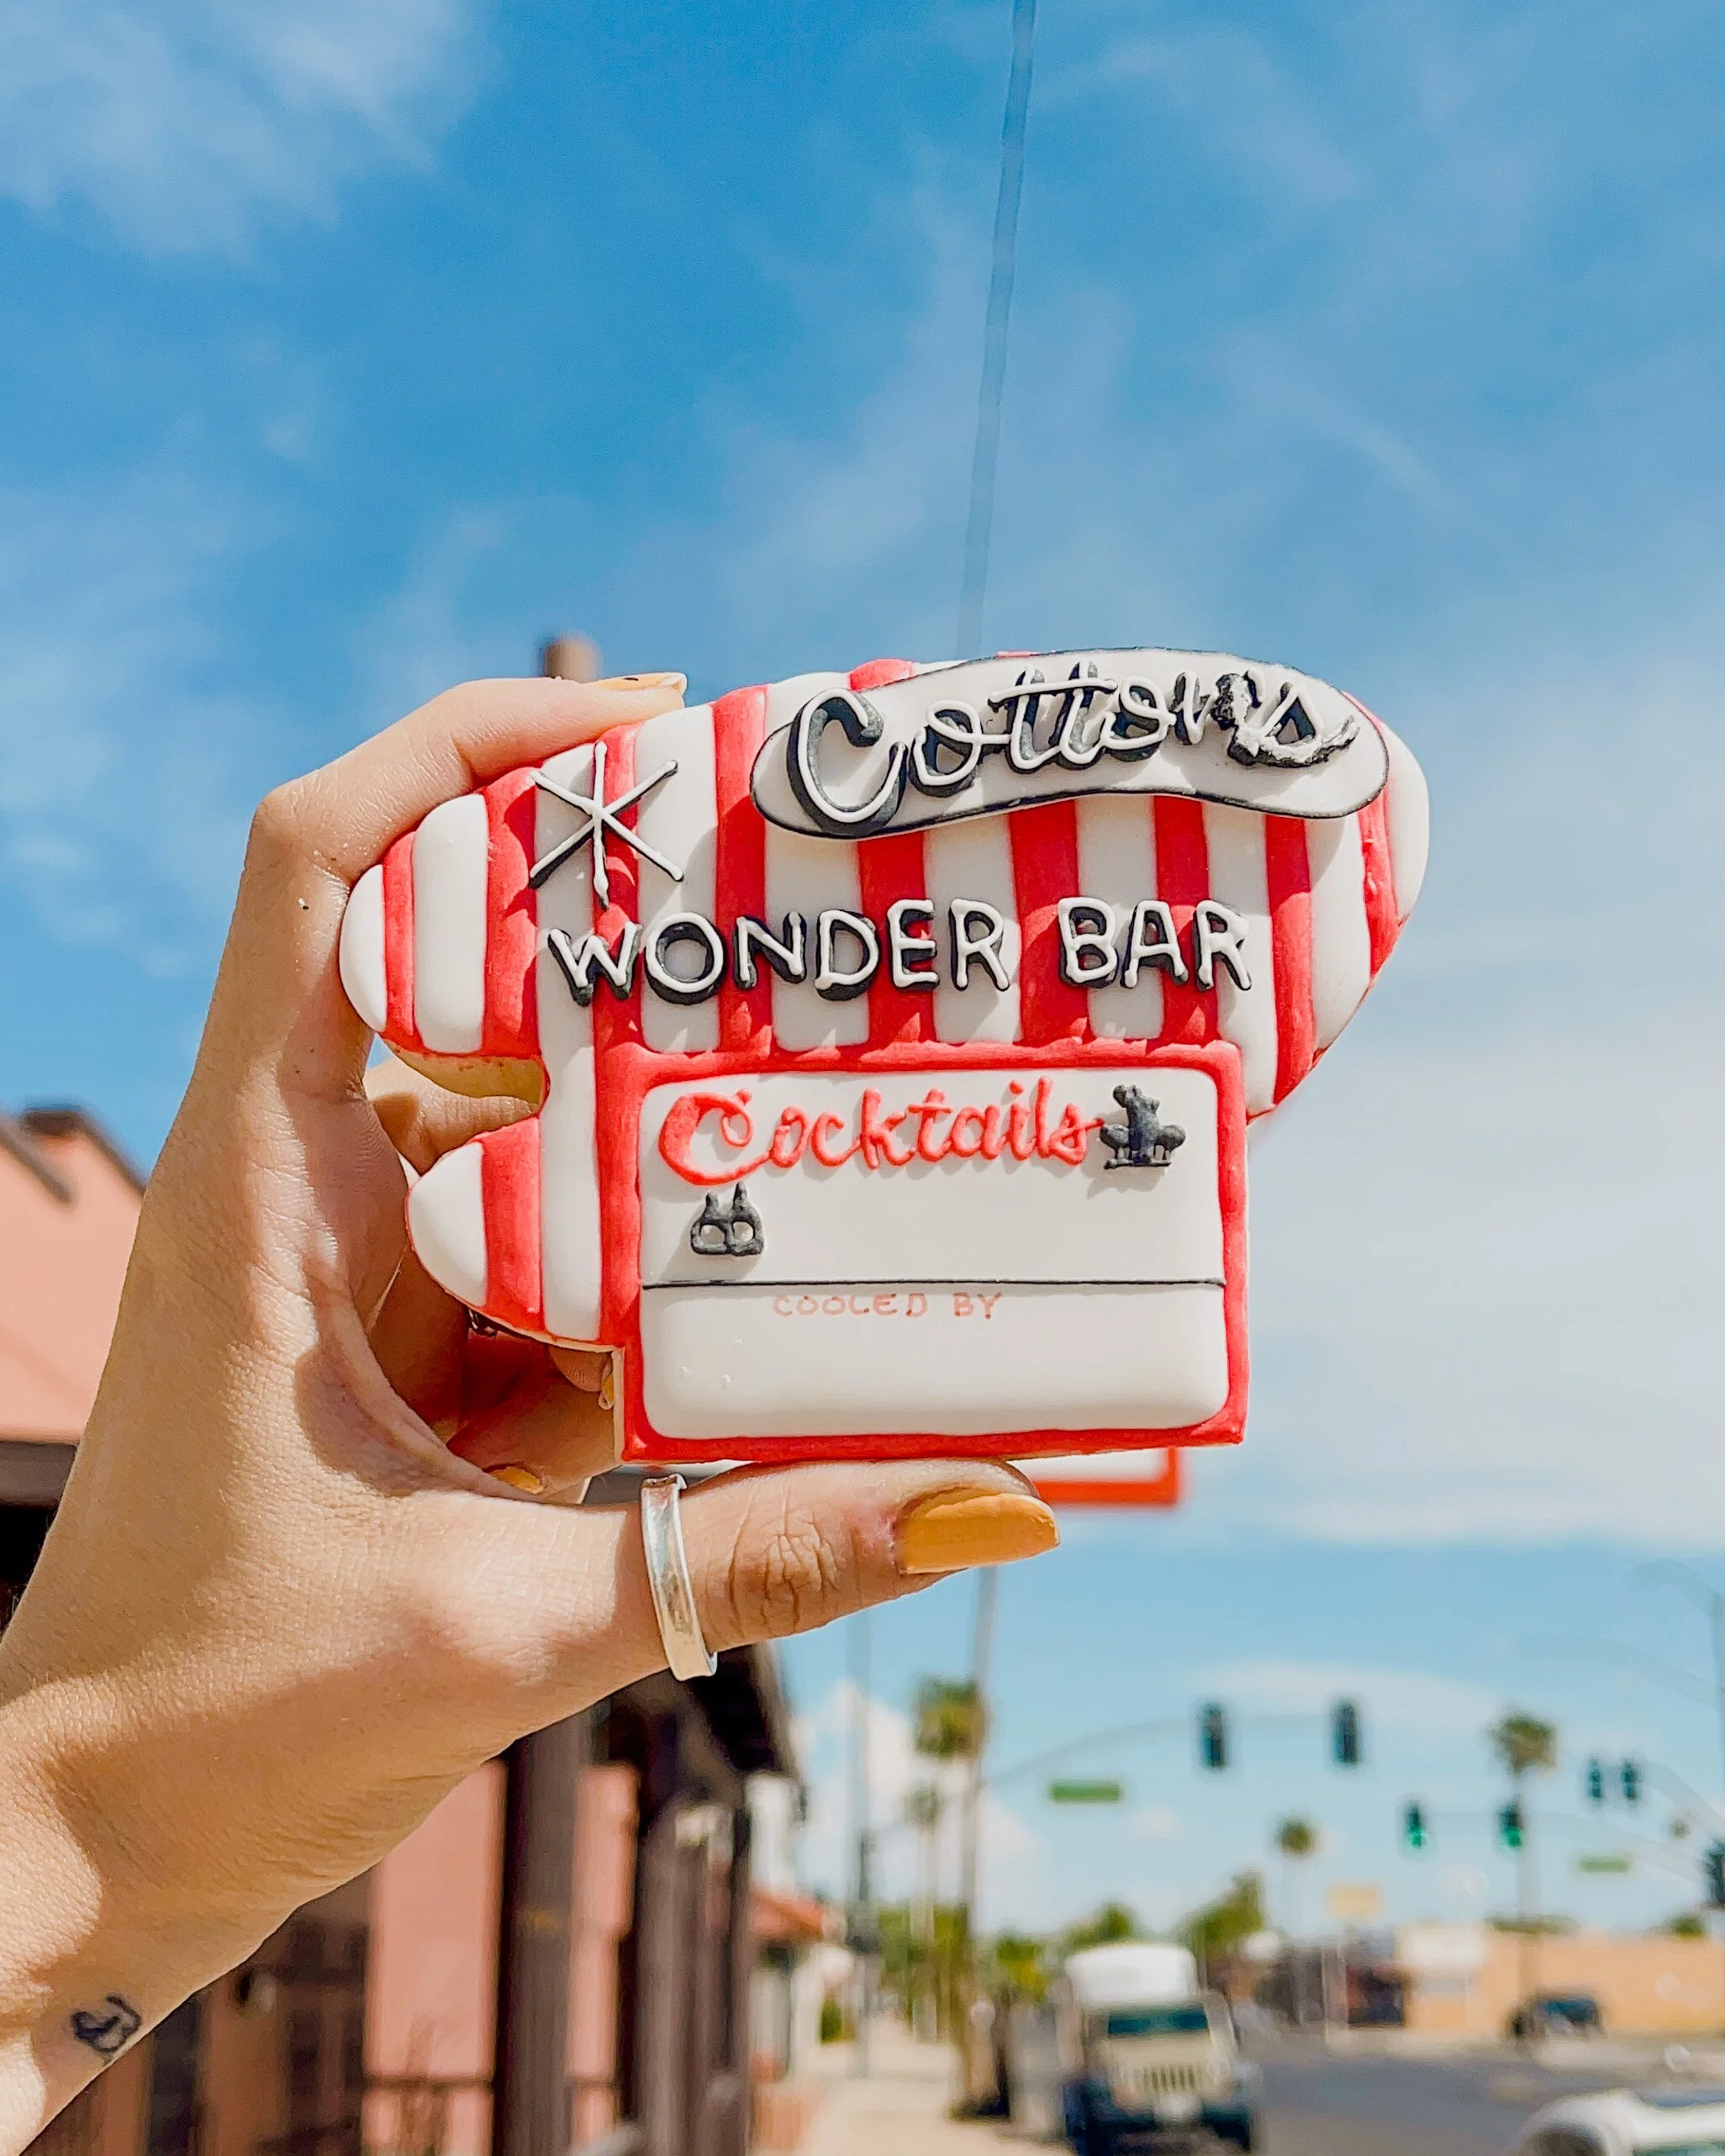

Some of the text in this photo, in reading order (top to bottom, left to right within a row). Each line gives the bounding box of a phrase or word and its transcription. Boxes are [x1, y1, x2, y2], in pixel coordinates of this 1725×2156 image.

[547, 897, 1253, 1005] WONDER BAR
[658, 1077, 1105, 1185] Cocktails
[773, 1292, 1003, 1320] COOLED BY
